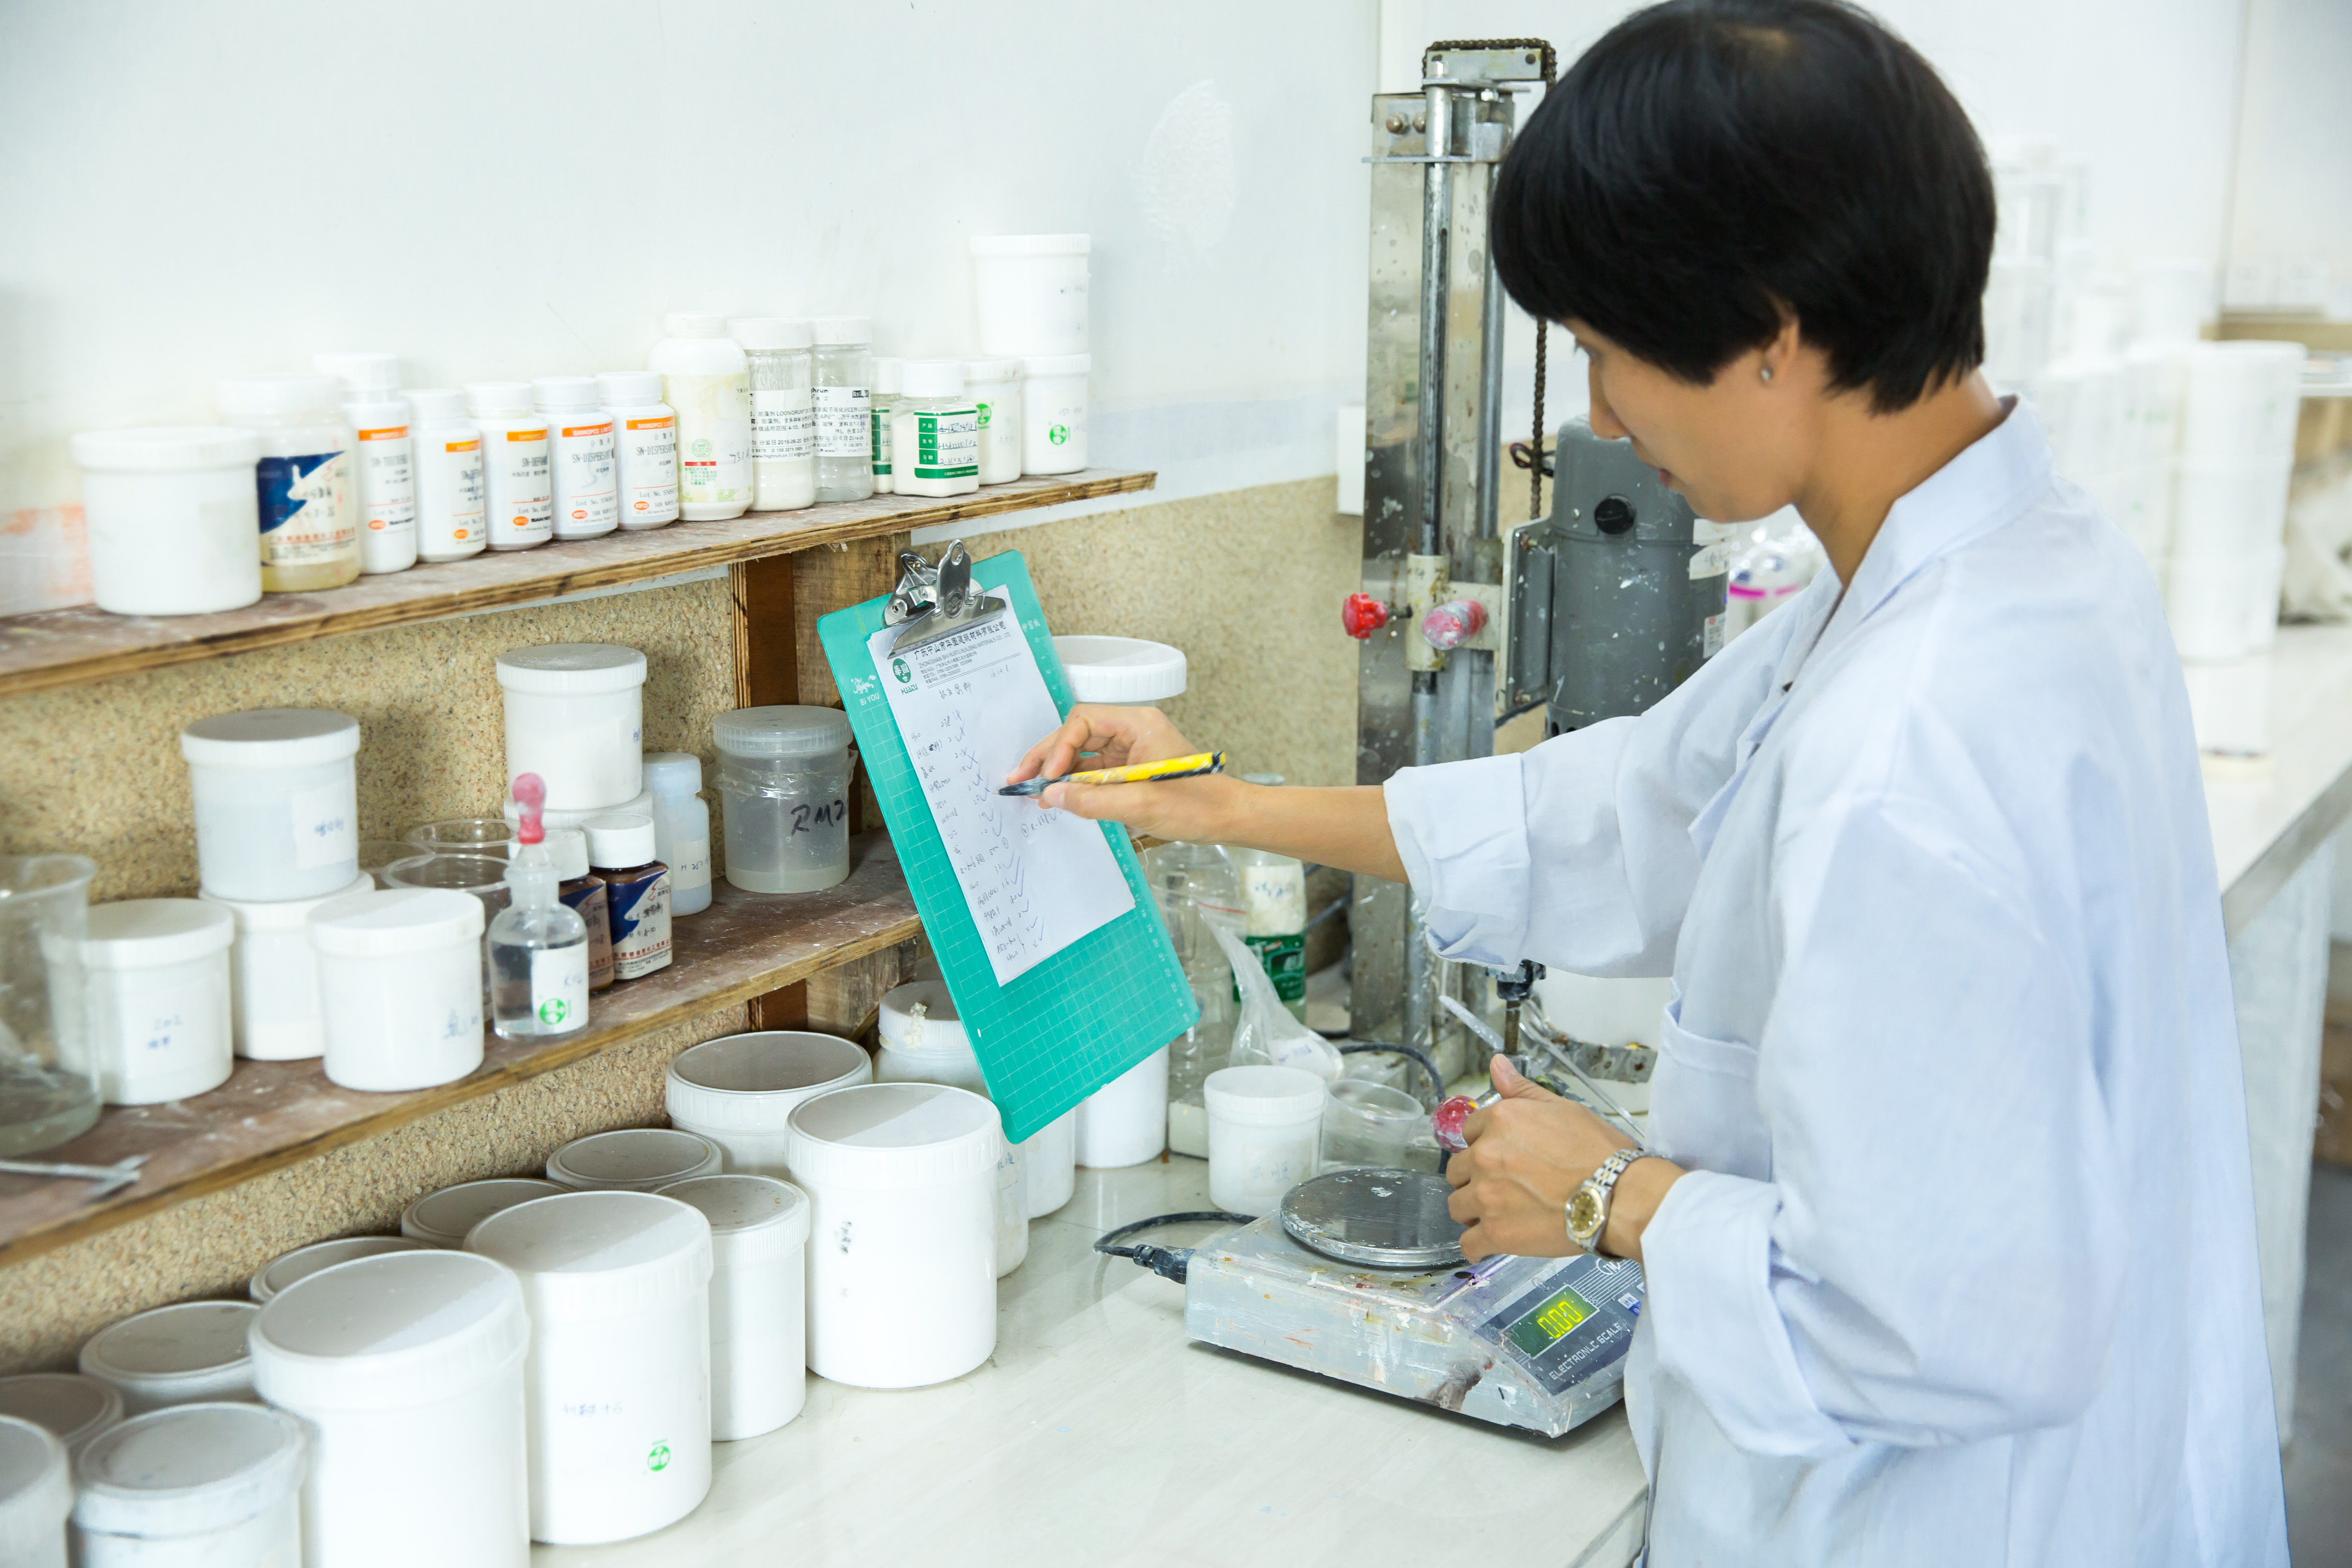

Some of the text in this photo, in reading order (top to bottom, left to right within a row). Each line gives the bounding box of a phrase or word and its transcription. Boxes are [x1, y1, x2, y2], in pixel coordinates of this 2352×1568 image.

[572, 428, 599, 436] SANNOPCO
[914, 621, 1006, 660] 广东中山市华图建筑材料有限公司
[860, 693, 880, 706] Bi YOU
[1537, 1301, 1583, 1339] 0.00
